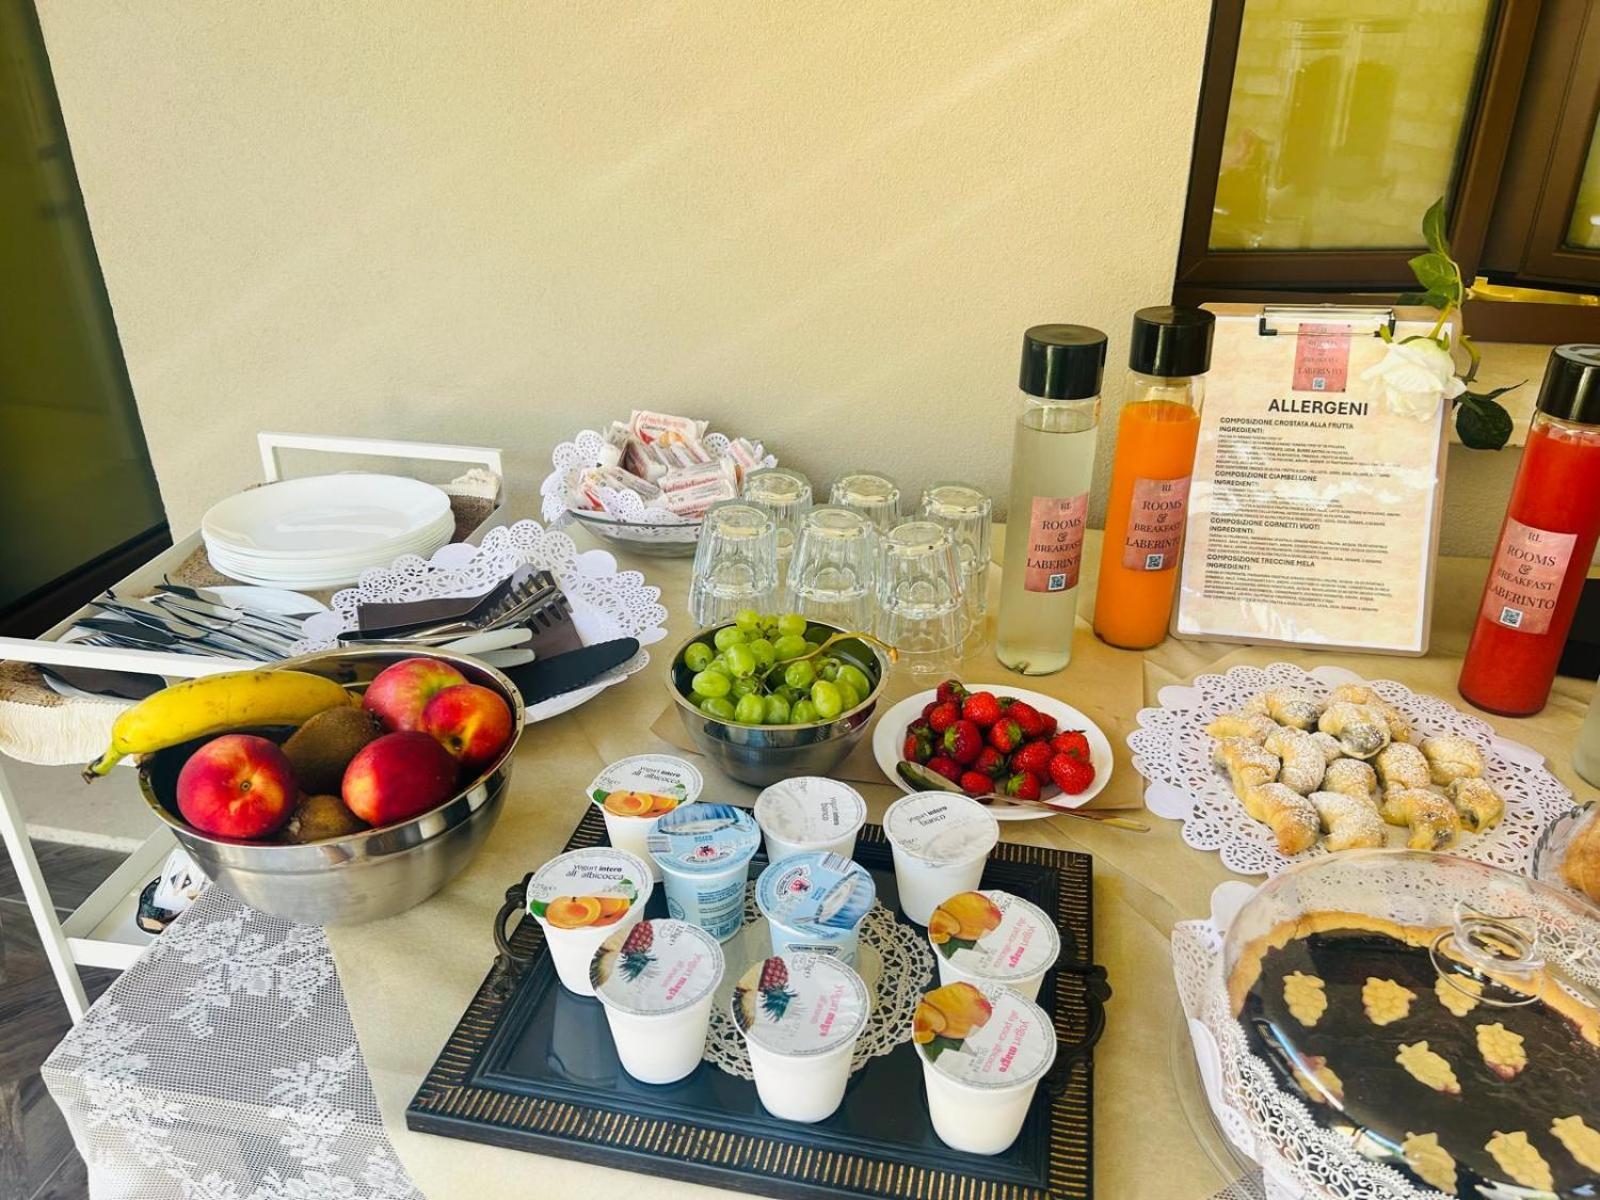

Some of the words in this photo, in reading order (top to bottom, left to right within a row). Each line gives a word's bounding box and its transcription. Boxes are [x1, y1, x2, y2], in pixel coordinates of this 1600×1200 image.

[1268, 398, 1369, 416] ALLERGENI
[1220, 417, 1273, 426] COMPOSIZIONE
[1274, 419, 1309, 428] CROSTATA
[1309, 420, 1327, 428] ALLA
[1328, 421, 1354, 429] FRUTTA
[1219, 426, 1265, 434] INGREDIENTI:
[1215, 470, 1268, 480] COMPOSIZIONE
[1269, 473, 1317, 482] CIAMBELLONE
[1142, 499, 1182, 510] ROOMS
[1042, 517, 1082, 530] ROOMS
[1157, 513, 1169, 523] &
[1210, 517, 1263, 527] COMPOSIZIONE
[1264, 520, 1298, 529] CORNETTI
[1299, 522, 1320, 530] VUOTI
[1209, 526, 1254, 534] INGREDIENTI:
[1057, 532, 1069, 543] &
[1528, 532, 1542, 543] RL
[1206, 554, 1260, 564] COMPOSIZIONE
[1260, 557, 1295, 566] TRECCINE
[1296, 559, 1315, 567] MELA
[1507, 545, 1557, 567] ROOMS
[1027, 557, 1079, 570] LABERINT
[1206, 562, 1251, 571] INGREDIENTI:
[1518, 563, 1533, 575] &
[1497, 567, 1555, 591] BREAKFAST
[1489, 583, 1556, 610] LABERINTO
[573, 864, 599, 875] yogurt
[581, 870, 625, 881] albicocca
[666, 975, 687, 1000] magro
[1015, 1019, 1030, 1047] yogurt
[999, 1045, 1018, 1073] magro
